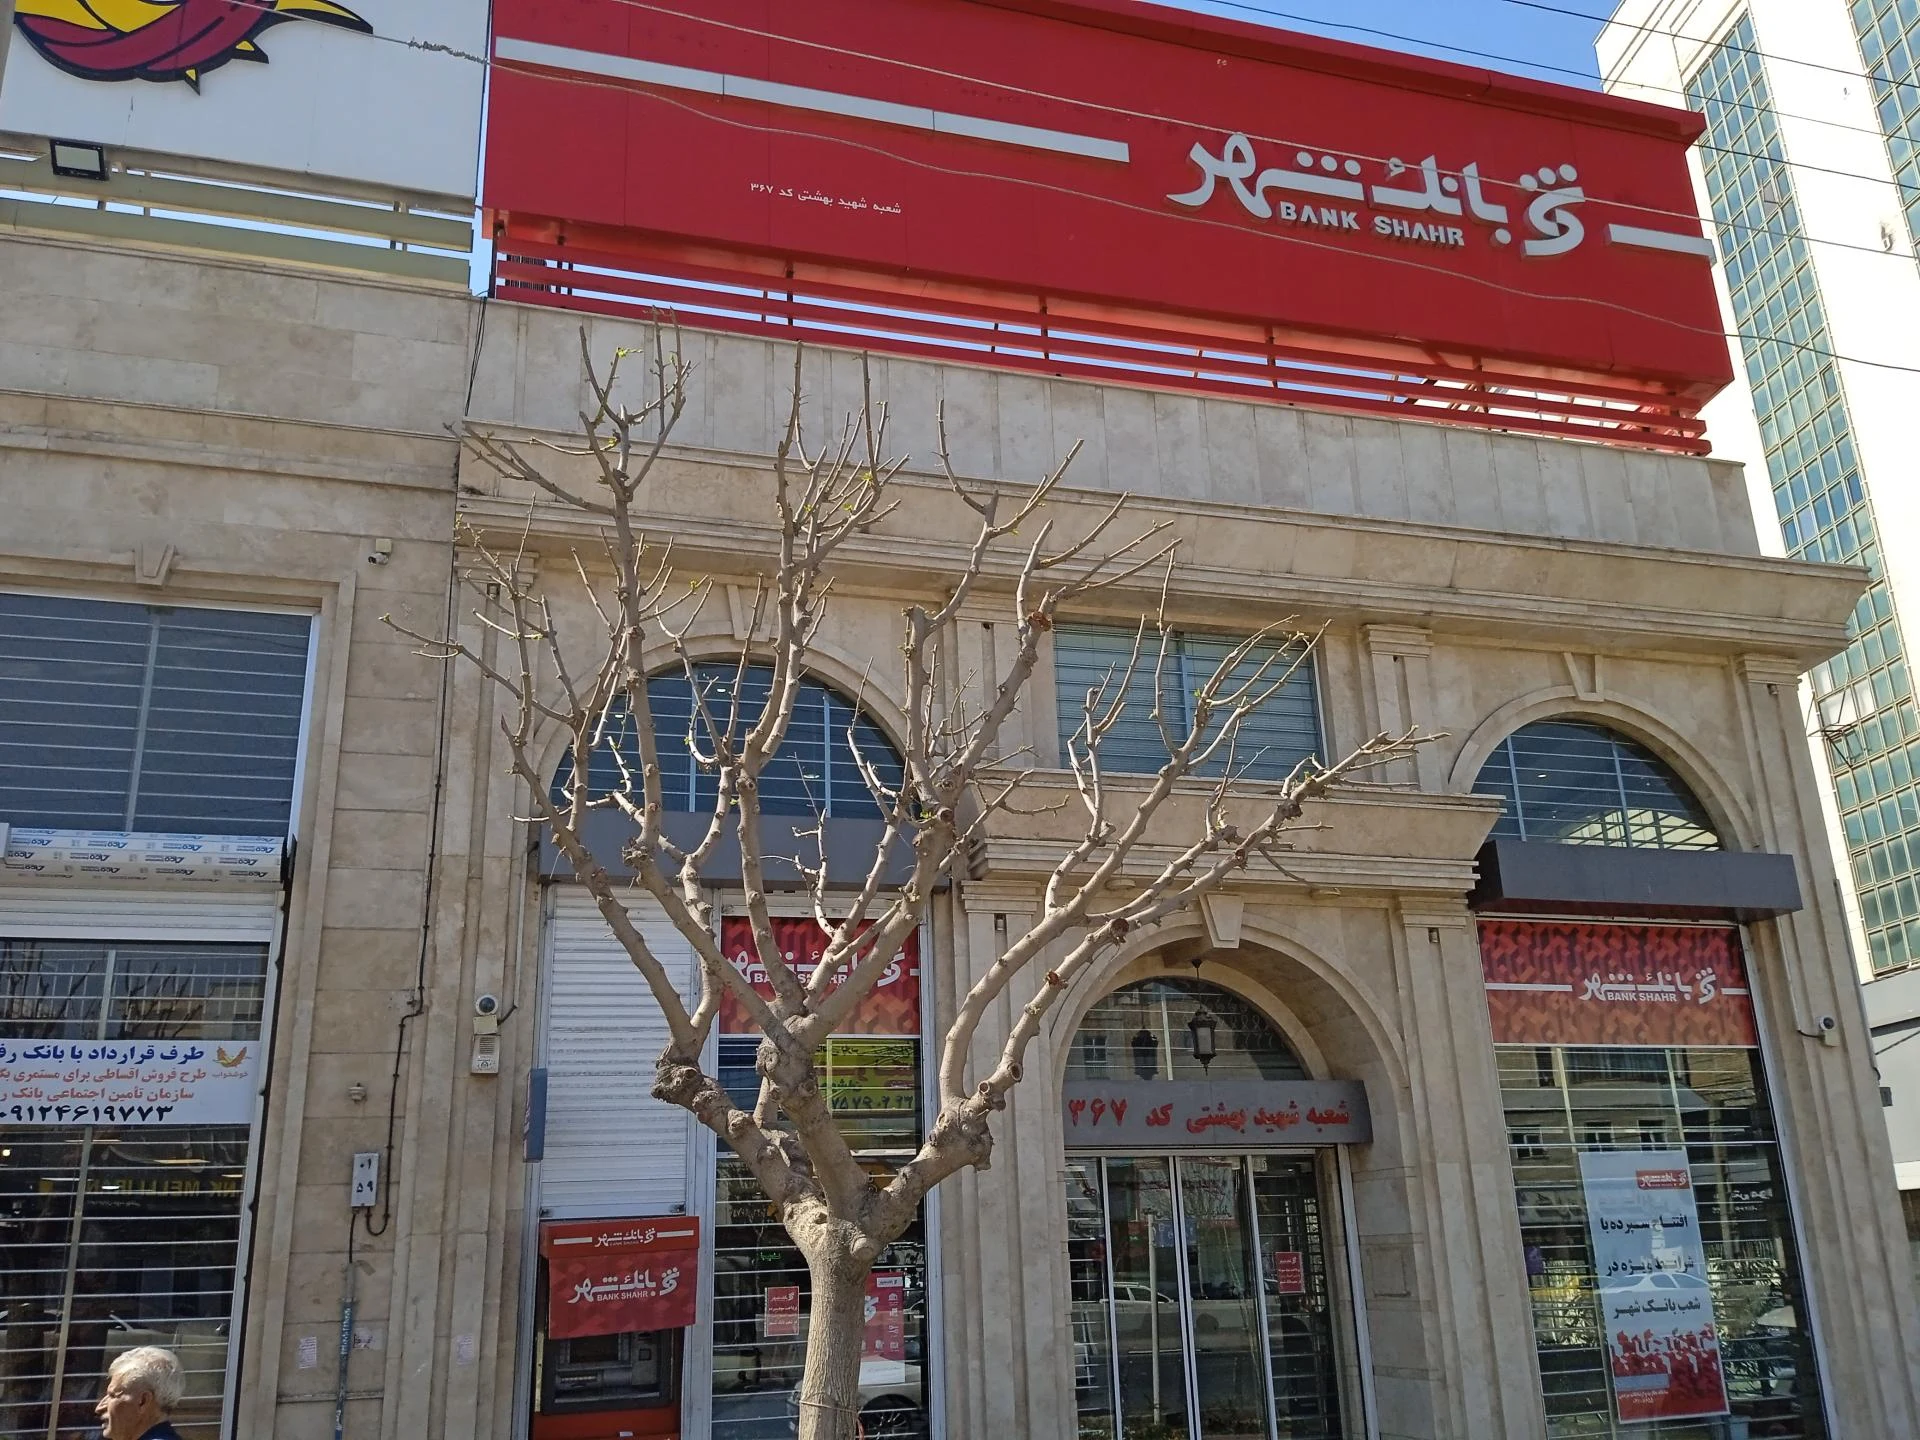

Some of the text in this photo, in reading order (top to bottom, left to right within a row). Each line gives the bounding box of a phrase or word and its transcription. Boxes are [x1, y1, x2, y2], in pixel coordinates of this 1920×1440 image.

[1166, 131, 1365, 220] شهر
[750, 182, 902, 215] شعبه شهید بهشتی کد ۳۶۷
[1279, 201, 1465, 247] BANK SHAHR
[1578, 973, 1636, 1001] شهر
[1607, 991, 1678, 1002] BANK SHAHR
[23, 1045, 65, 1063] بانک
[70, 1045, 83, 1063] با
[88, 1044, 155, 1064] قرارداد
[160, 1044, 205, 1064] طرف
[13, 1069, 60, 1083] مستمری
[63, 1068, 91, 1083] برای
[93, 1067, 139, 1082] اقساطی
[142, 1067, 177, 1083] فروش
[179, 1068, 207, 1083] طرح
[12, 1087, 43, 1102] بانک
[47, 1087, 106, 1102] اجتماعی
[147, 1088, 194, 1103] سازمان
[0, 1105, 174, 1122] ۰۹۱۲۴۶۱۹۷۷۳
[1068, 1098, 1350, 1134] شعبه شهید بهشتی کد ۳۶۷
[356, 1181, 373, 1192] ۵۹
[1600, 1217, 1609, 1233] با
[1611, 1218, 1650, 1235] سپرده
[1606, 1261, 1619, 1277] در
[567, 1276, 619, 1304] شهر
[621, 1291, 648, 1300] SHAHR
[1613, 1296, 1701, 1319] شعب بانک شهر
